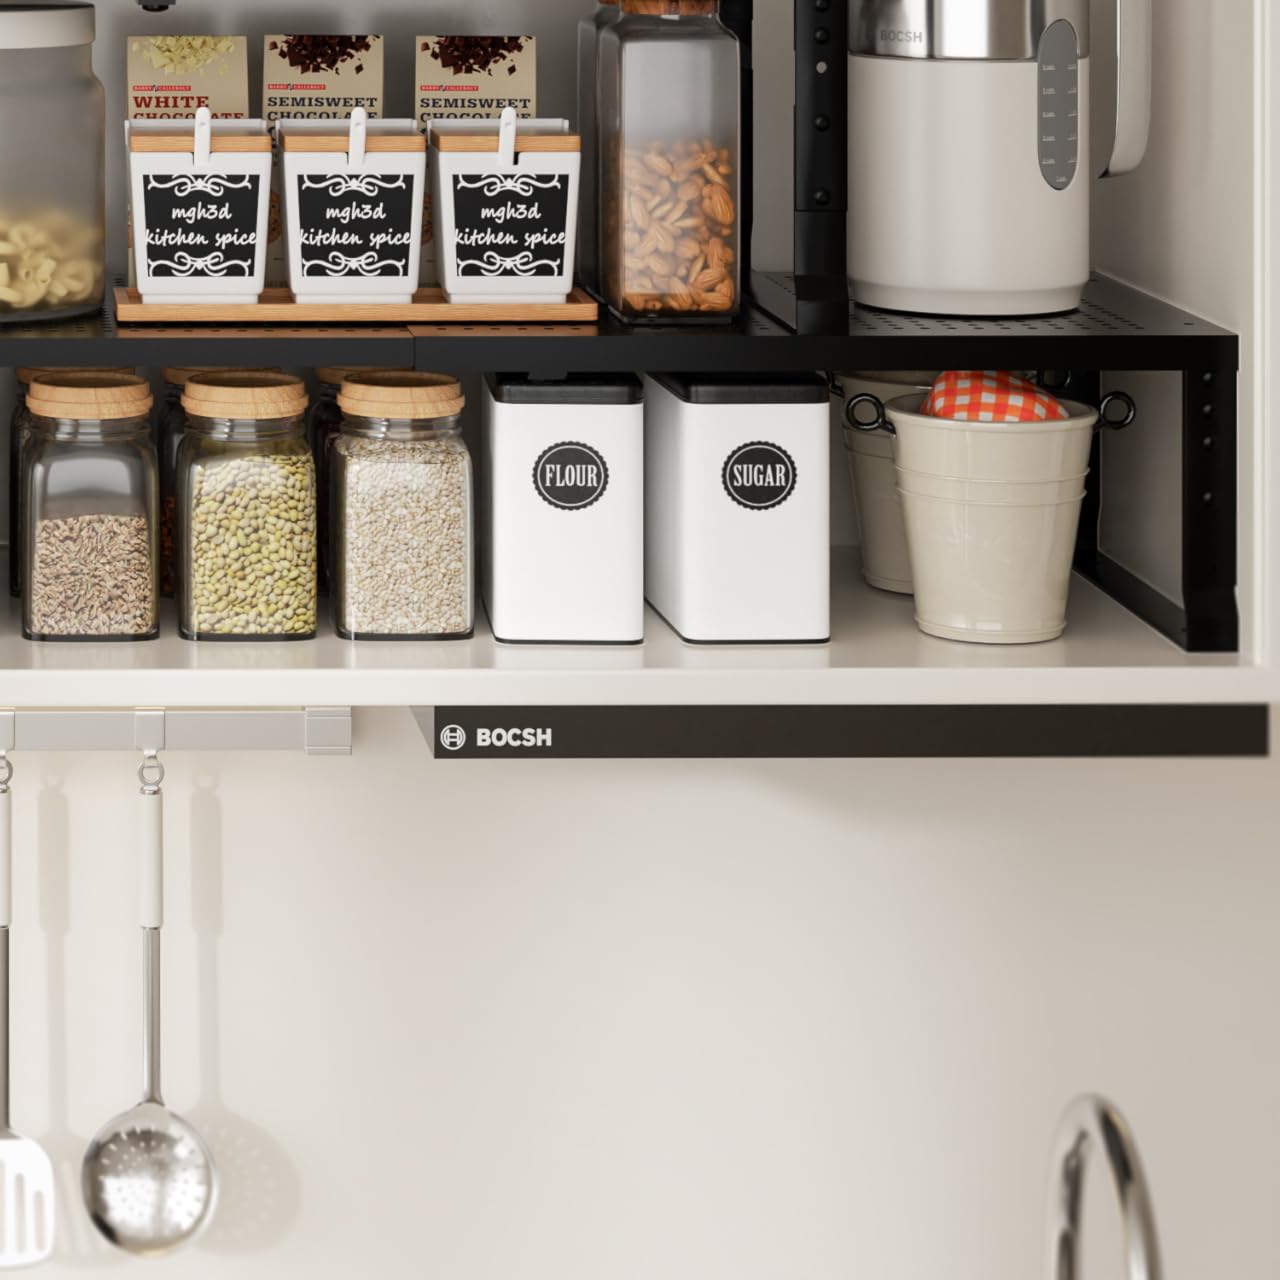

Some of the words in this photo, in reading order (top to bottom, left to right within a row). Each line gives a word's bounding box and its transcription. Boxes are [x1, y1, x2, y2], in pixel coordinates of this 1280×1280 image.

[880, 30, 923, 43] BOCSH
[133, 96, 209, 109] WHITE
[267, 97, 378, 107] SEMISWEET
[420, 98, 531, 109] SEMISWEET
[171, 201, 232, 224] mgh3d
[325, 201, 387, 224] mgh3d
[480, 201, 542, 224] mgh3d
[146, 227, 209, 247] kitchen
[215, 227, 257, 250] spice
[300, 227, 363, 247] kitchen
[369, 227, 411, 250] spice
[455, 227, 518, 247] kitchen
[524, 227, 566, 250] spice
[545, 464, 598, 487] FLOUR
[733, 463, 786, 487] SUGAR
[476, 727, 552, 747] BOCSH
